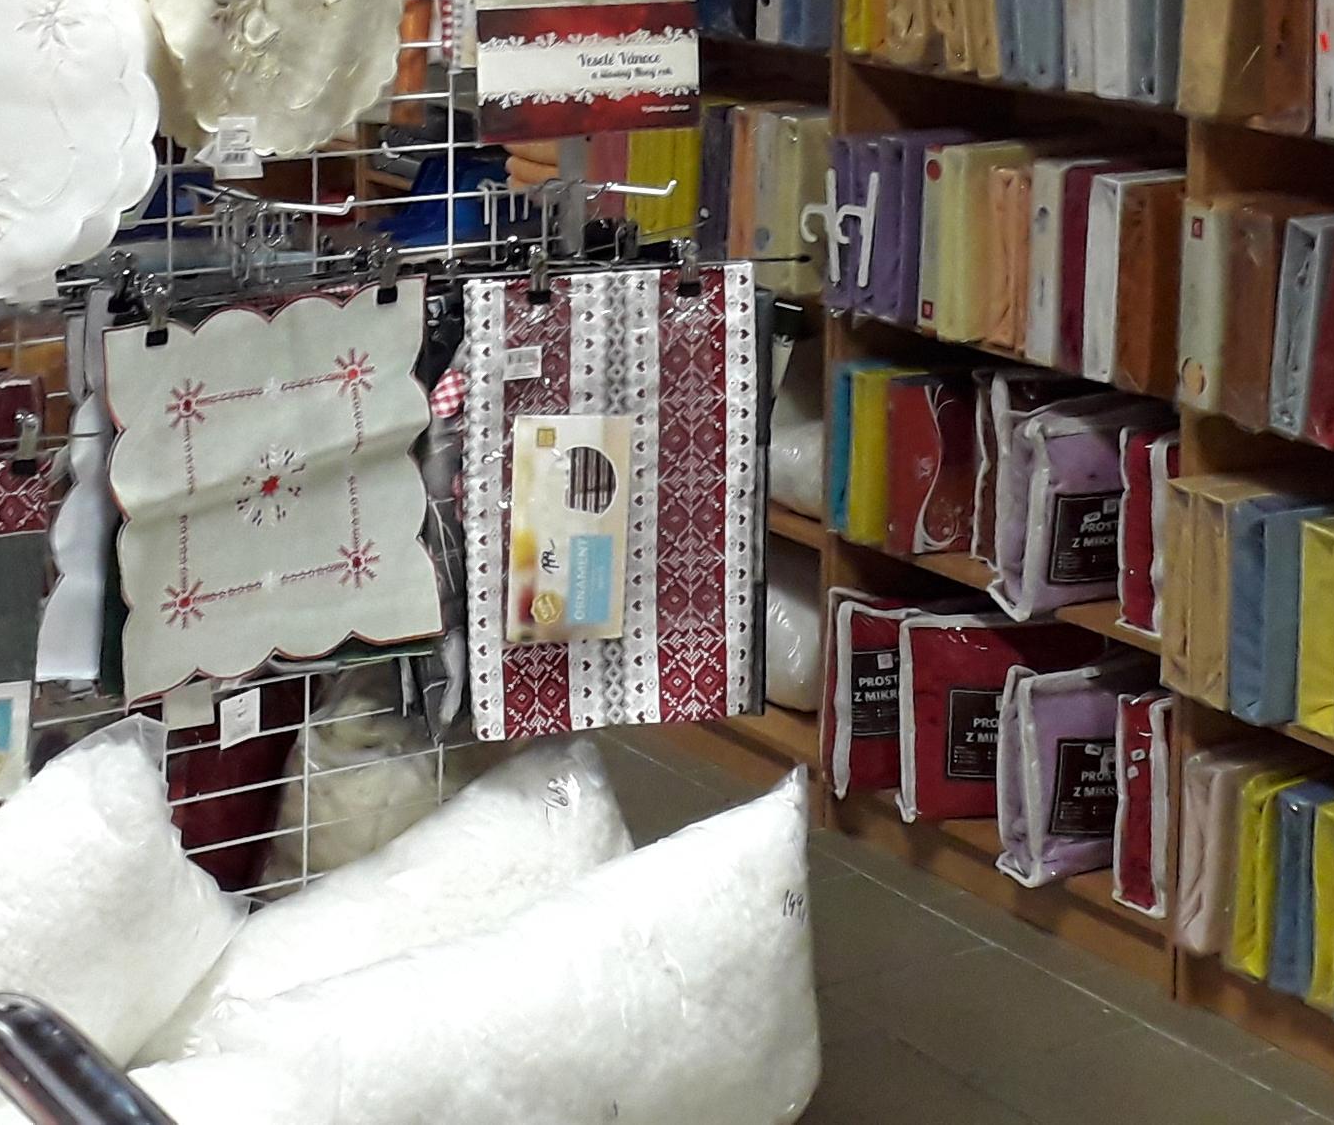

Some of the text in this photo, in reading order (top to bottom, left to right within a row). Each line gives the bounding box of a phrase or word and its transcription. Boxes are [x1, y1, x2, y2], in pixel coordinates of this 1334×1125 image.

[576, 49, 662, 68] Veselé Vánoce
[1071, 537, 1081, 548] Z
[573, 537, 590, 621] ORNAMENT
[853, 691, 864, 703] Z
[965, 732, 974, 743] Z
[1072, 786, 1082, 798] Z
